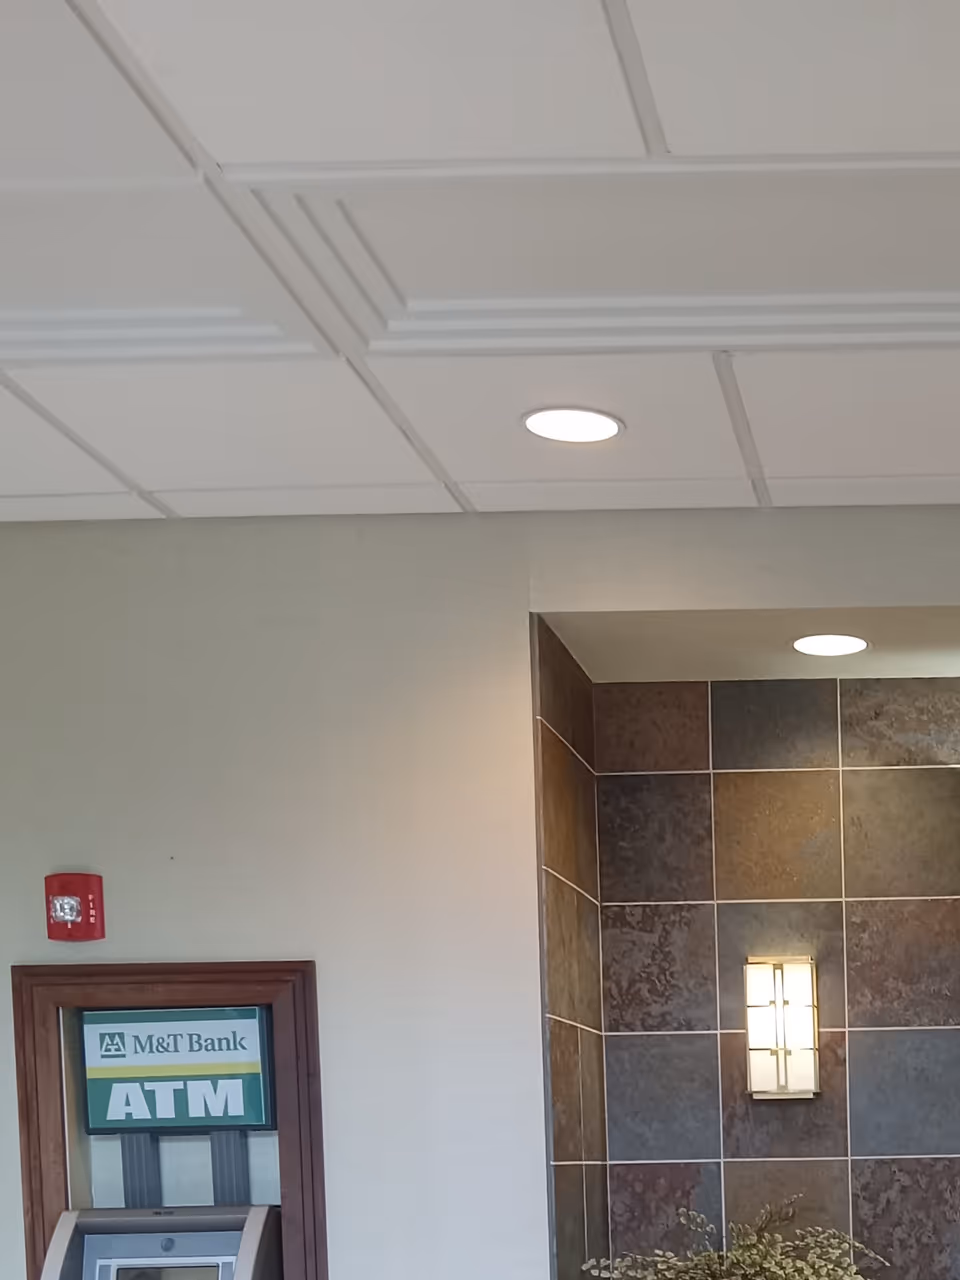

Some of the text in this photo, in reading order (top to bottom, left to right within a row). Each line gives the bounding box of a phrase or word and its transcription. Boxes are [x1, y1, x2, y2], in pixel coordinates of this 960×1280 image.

[132, 1031, 248, 1054] M&T Bank
[106, 1078, 245, 1121] ATM
